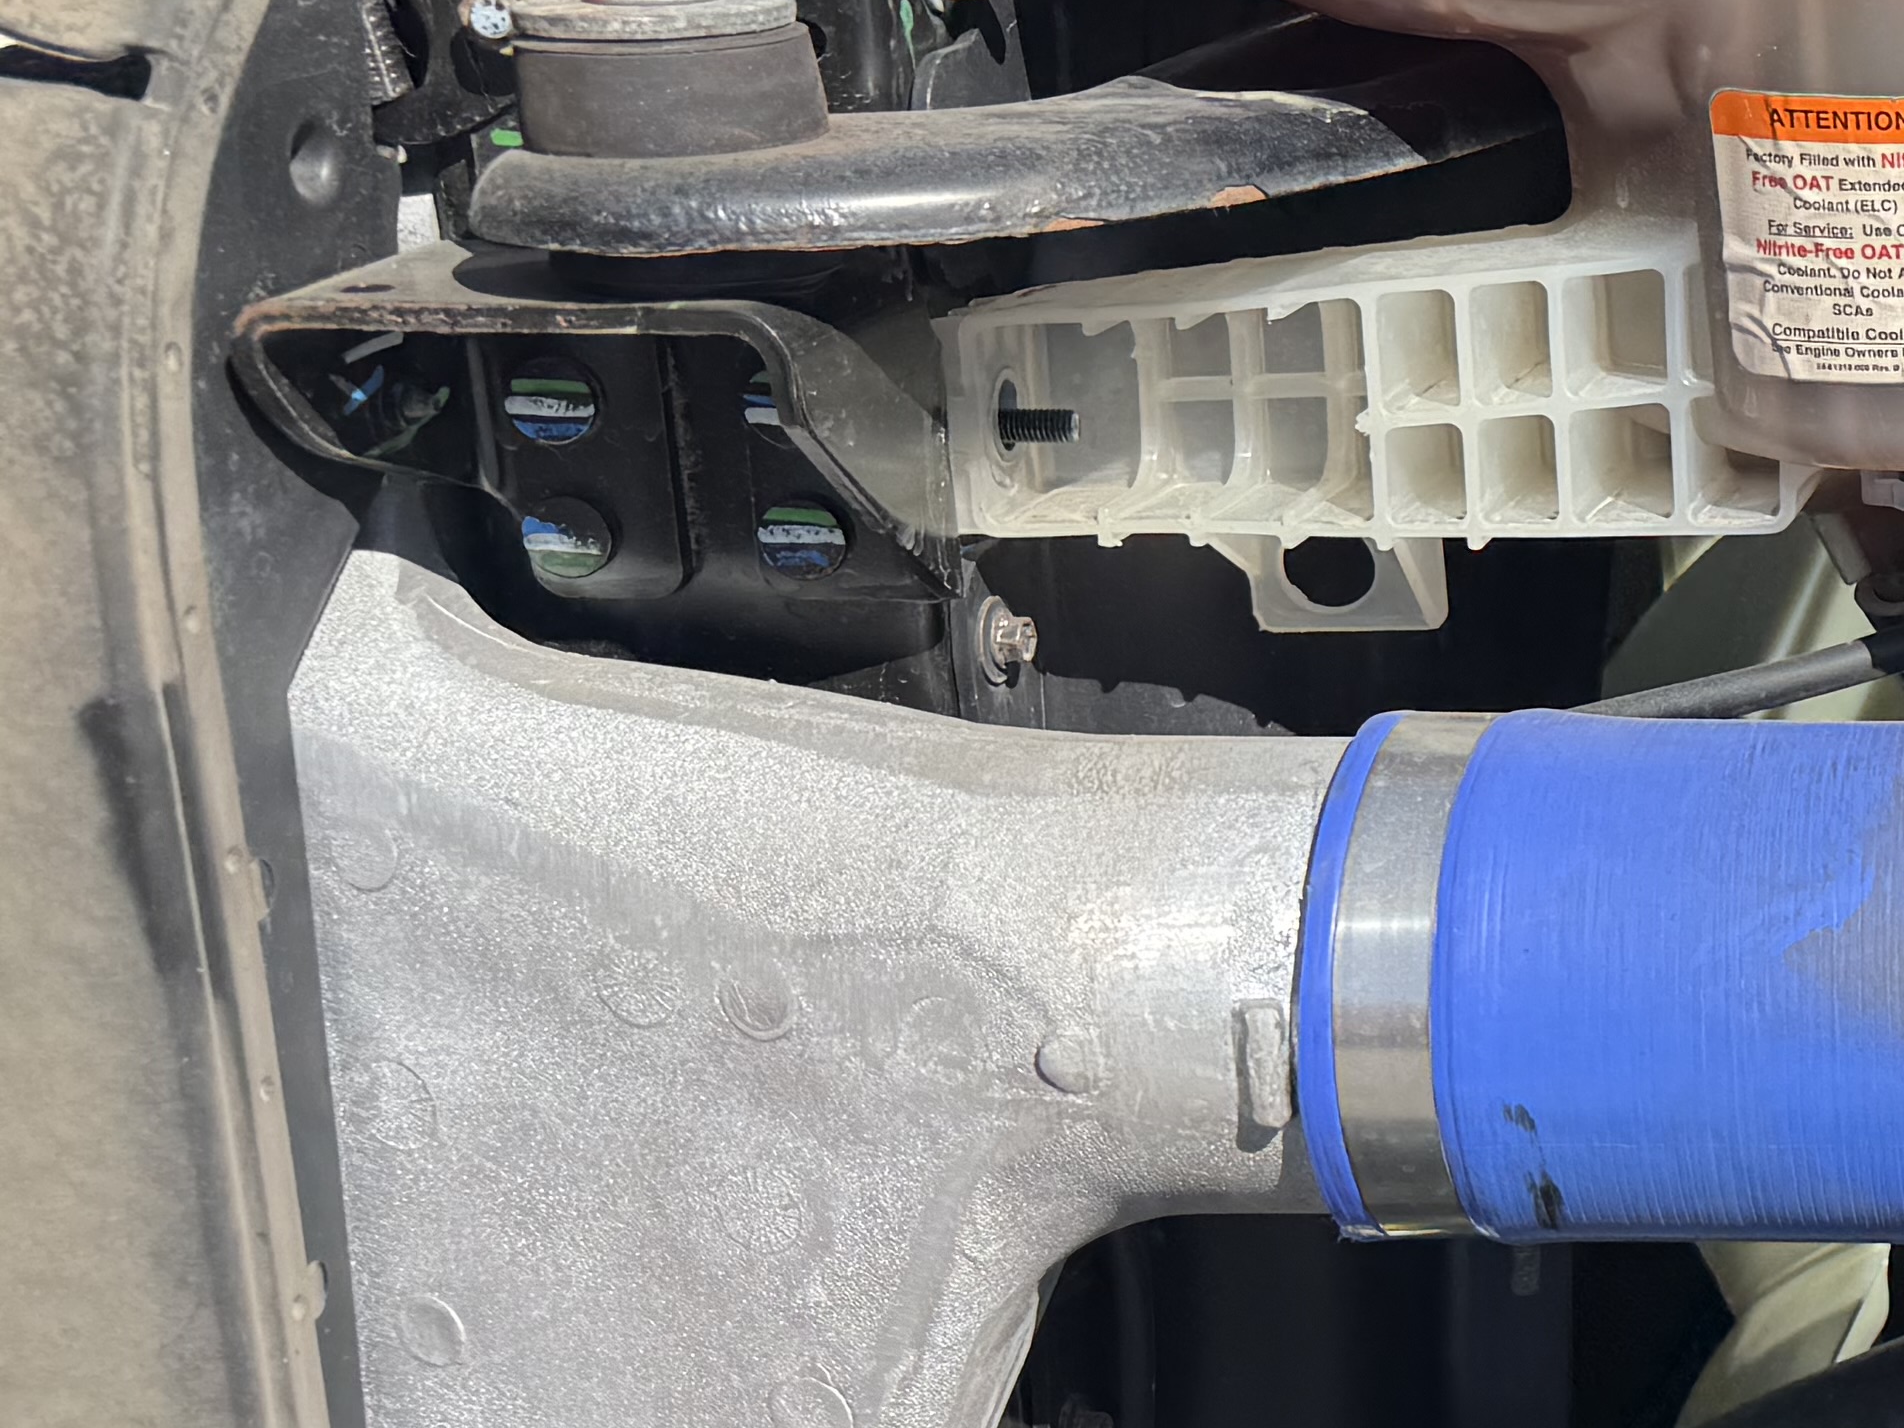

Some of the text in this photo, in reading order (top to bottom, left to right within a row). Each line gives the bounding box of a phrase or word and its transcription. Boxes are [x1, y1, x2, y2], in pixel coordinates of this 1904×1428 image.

[1746, 148, 1794, 169] Factory
[1799, 152, 1840, 167] Filled
[1843, 153, 1876, 168] with
[1752, 171, 1788, 189] Free
[1792, 174, 1834, 192] OAT
[1793, 197, 1899, 215] Coolant (ELC)
[1768, 219, 1789, 235] For
[1793, 221, 1854, 239] Service:
[1862, 224, 1892, 237] Use
[1756, 238, 1855, 260] Nitrite-Free
[1841, 267, 1860, 279] Do
[1866, 267, 1893, 280] Not
[1763, 279, 1854, 298] Conventional
[1832, 303, 1873, 317] SCAs
[1772, 322, 1860, 341] Compatible
[1796, 345, 1840, 358] Engine
